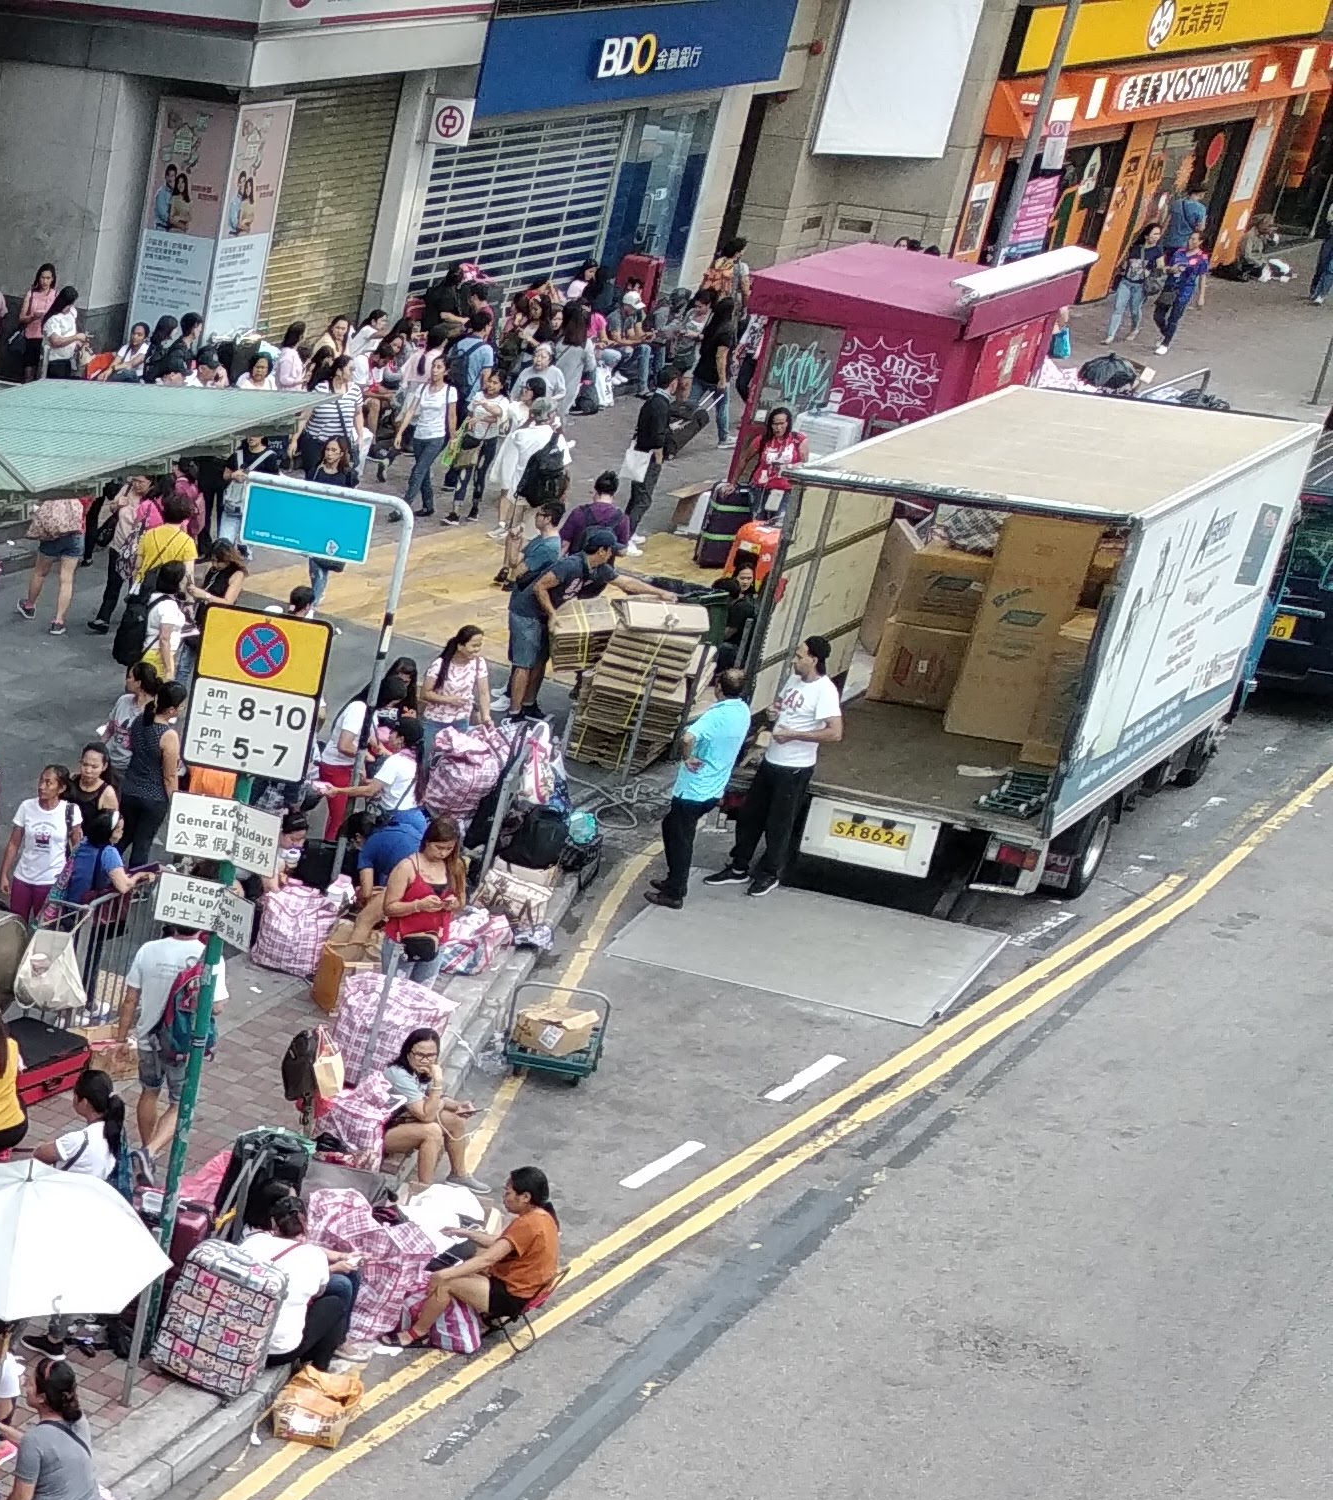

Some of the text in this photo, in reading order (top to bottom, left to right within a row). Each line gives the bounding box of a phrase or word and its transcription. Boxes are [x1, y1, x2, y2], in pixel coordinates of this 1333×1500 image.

[597, 33, 657, 78] BDO
[207, 687, 229, 700] am
[197, 697, 307, 731] 上午 8-10
[200, 726, 222, 739] pm
[193, 739, 226, 758] 下午
[176, 812, 274, 847] General Holidays
[834, 820, 908, 847] SA8624
[171, 891, 196, 905] pick
